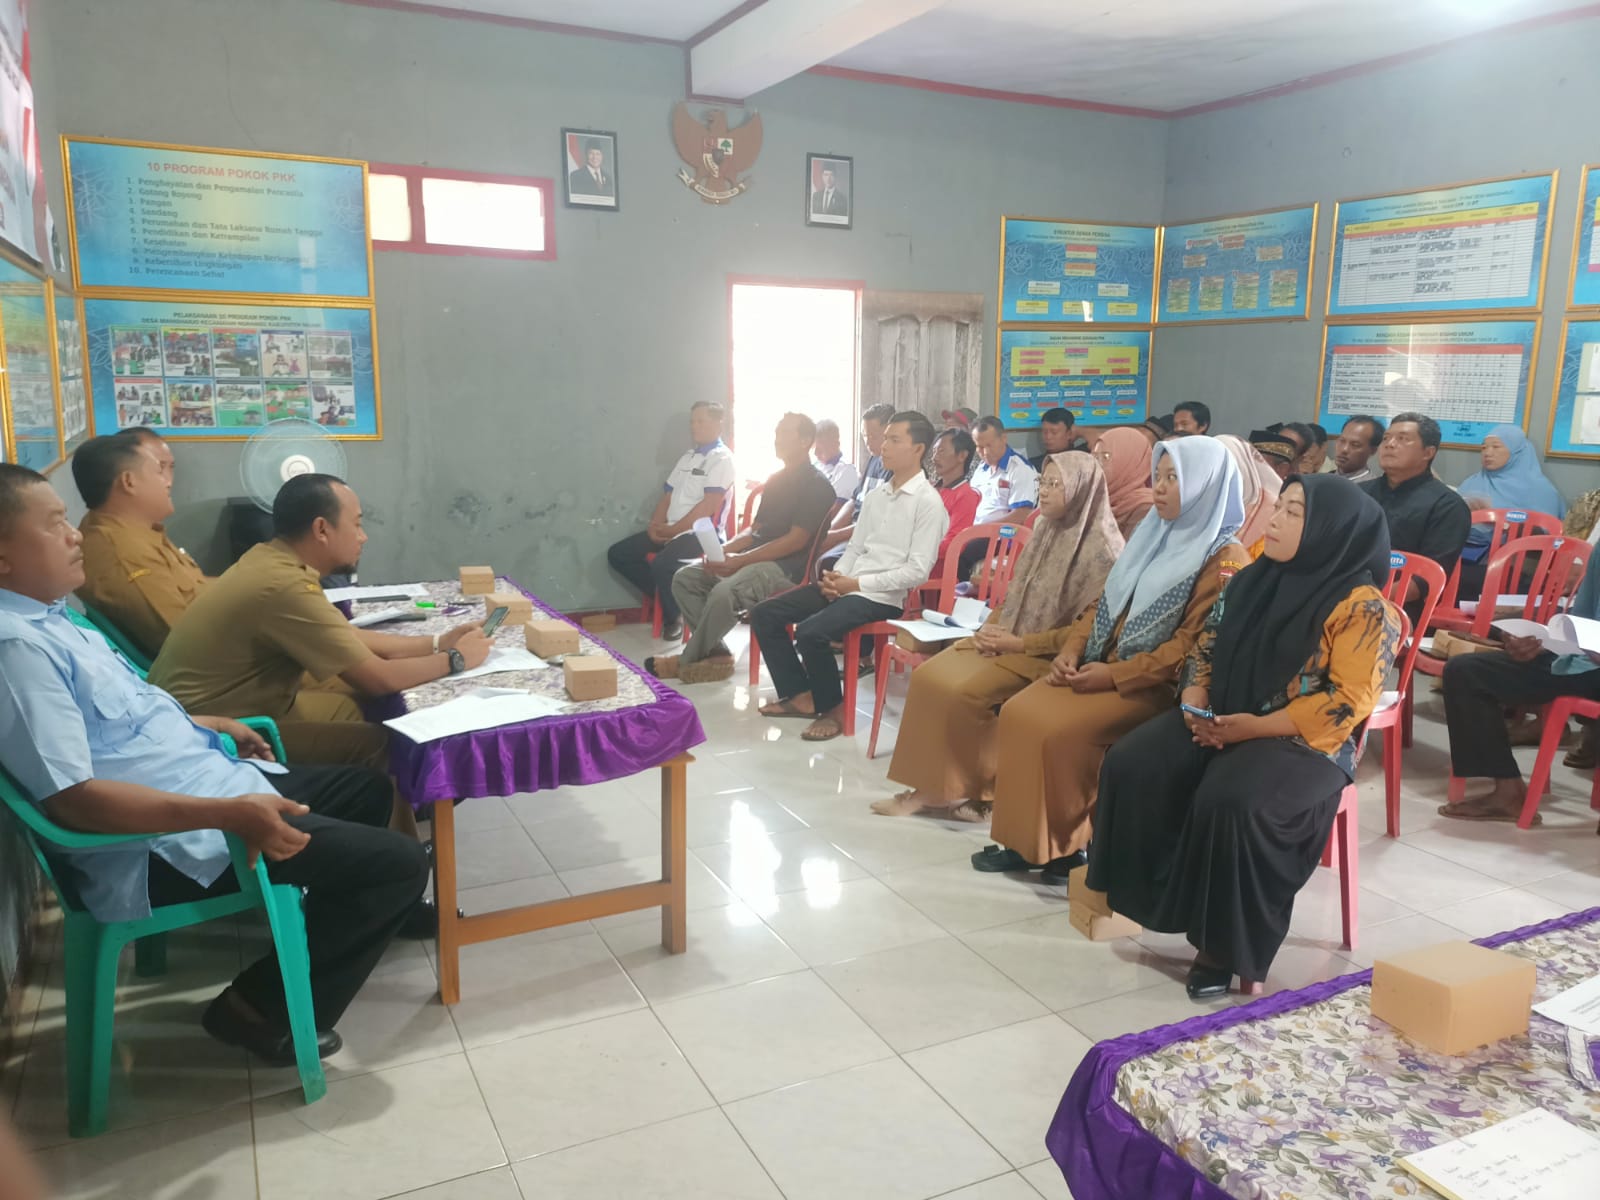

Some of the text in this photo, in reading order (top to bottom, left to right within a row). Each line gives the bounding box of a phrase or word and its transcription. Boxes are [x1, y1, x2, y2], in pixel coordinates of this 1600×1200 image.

[147, 162, 296, 182] 10 PROGRAM POKOK PKK
[196, 182, 212, 190] dan
[138, 188, 169, 197] Gotong
[171, 191, 202, 200] Royong
[140, 198, 172, 207] Pangan
[141, 208, 178, 218] Sandang
[142, 218, 190, 227] Perumahan
[142, 228, 190, 237] Pendidikan
